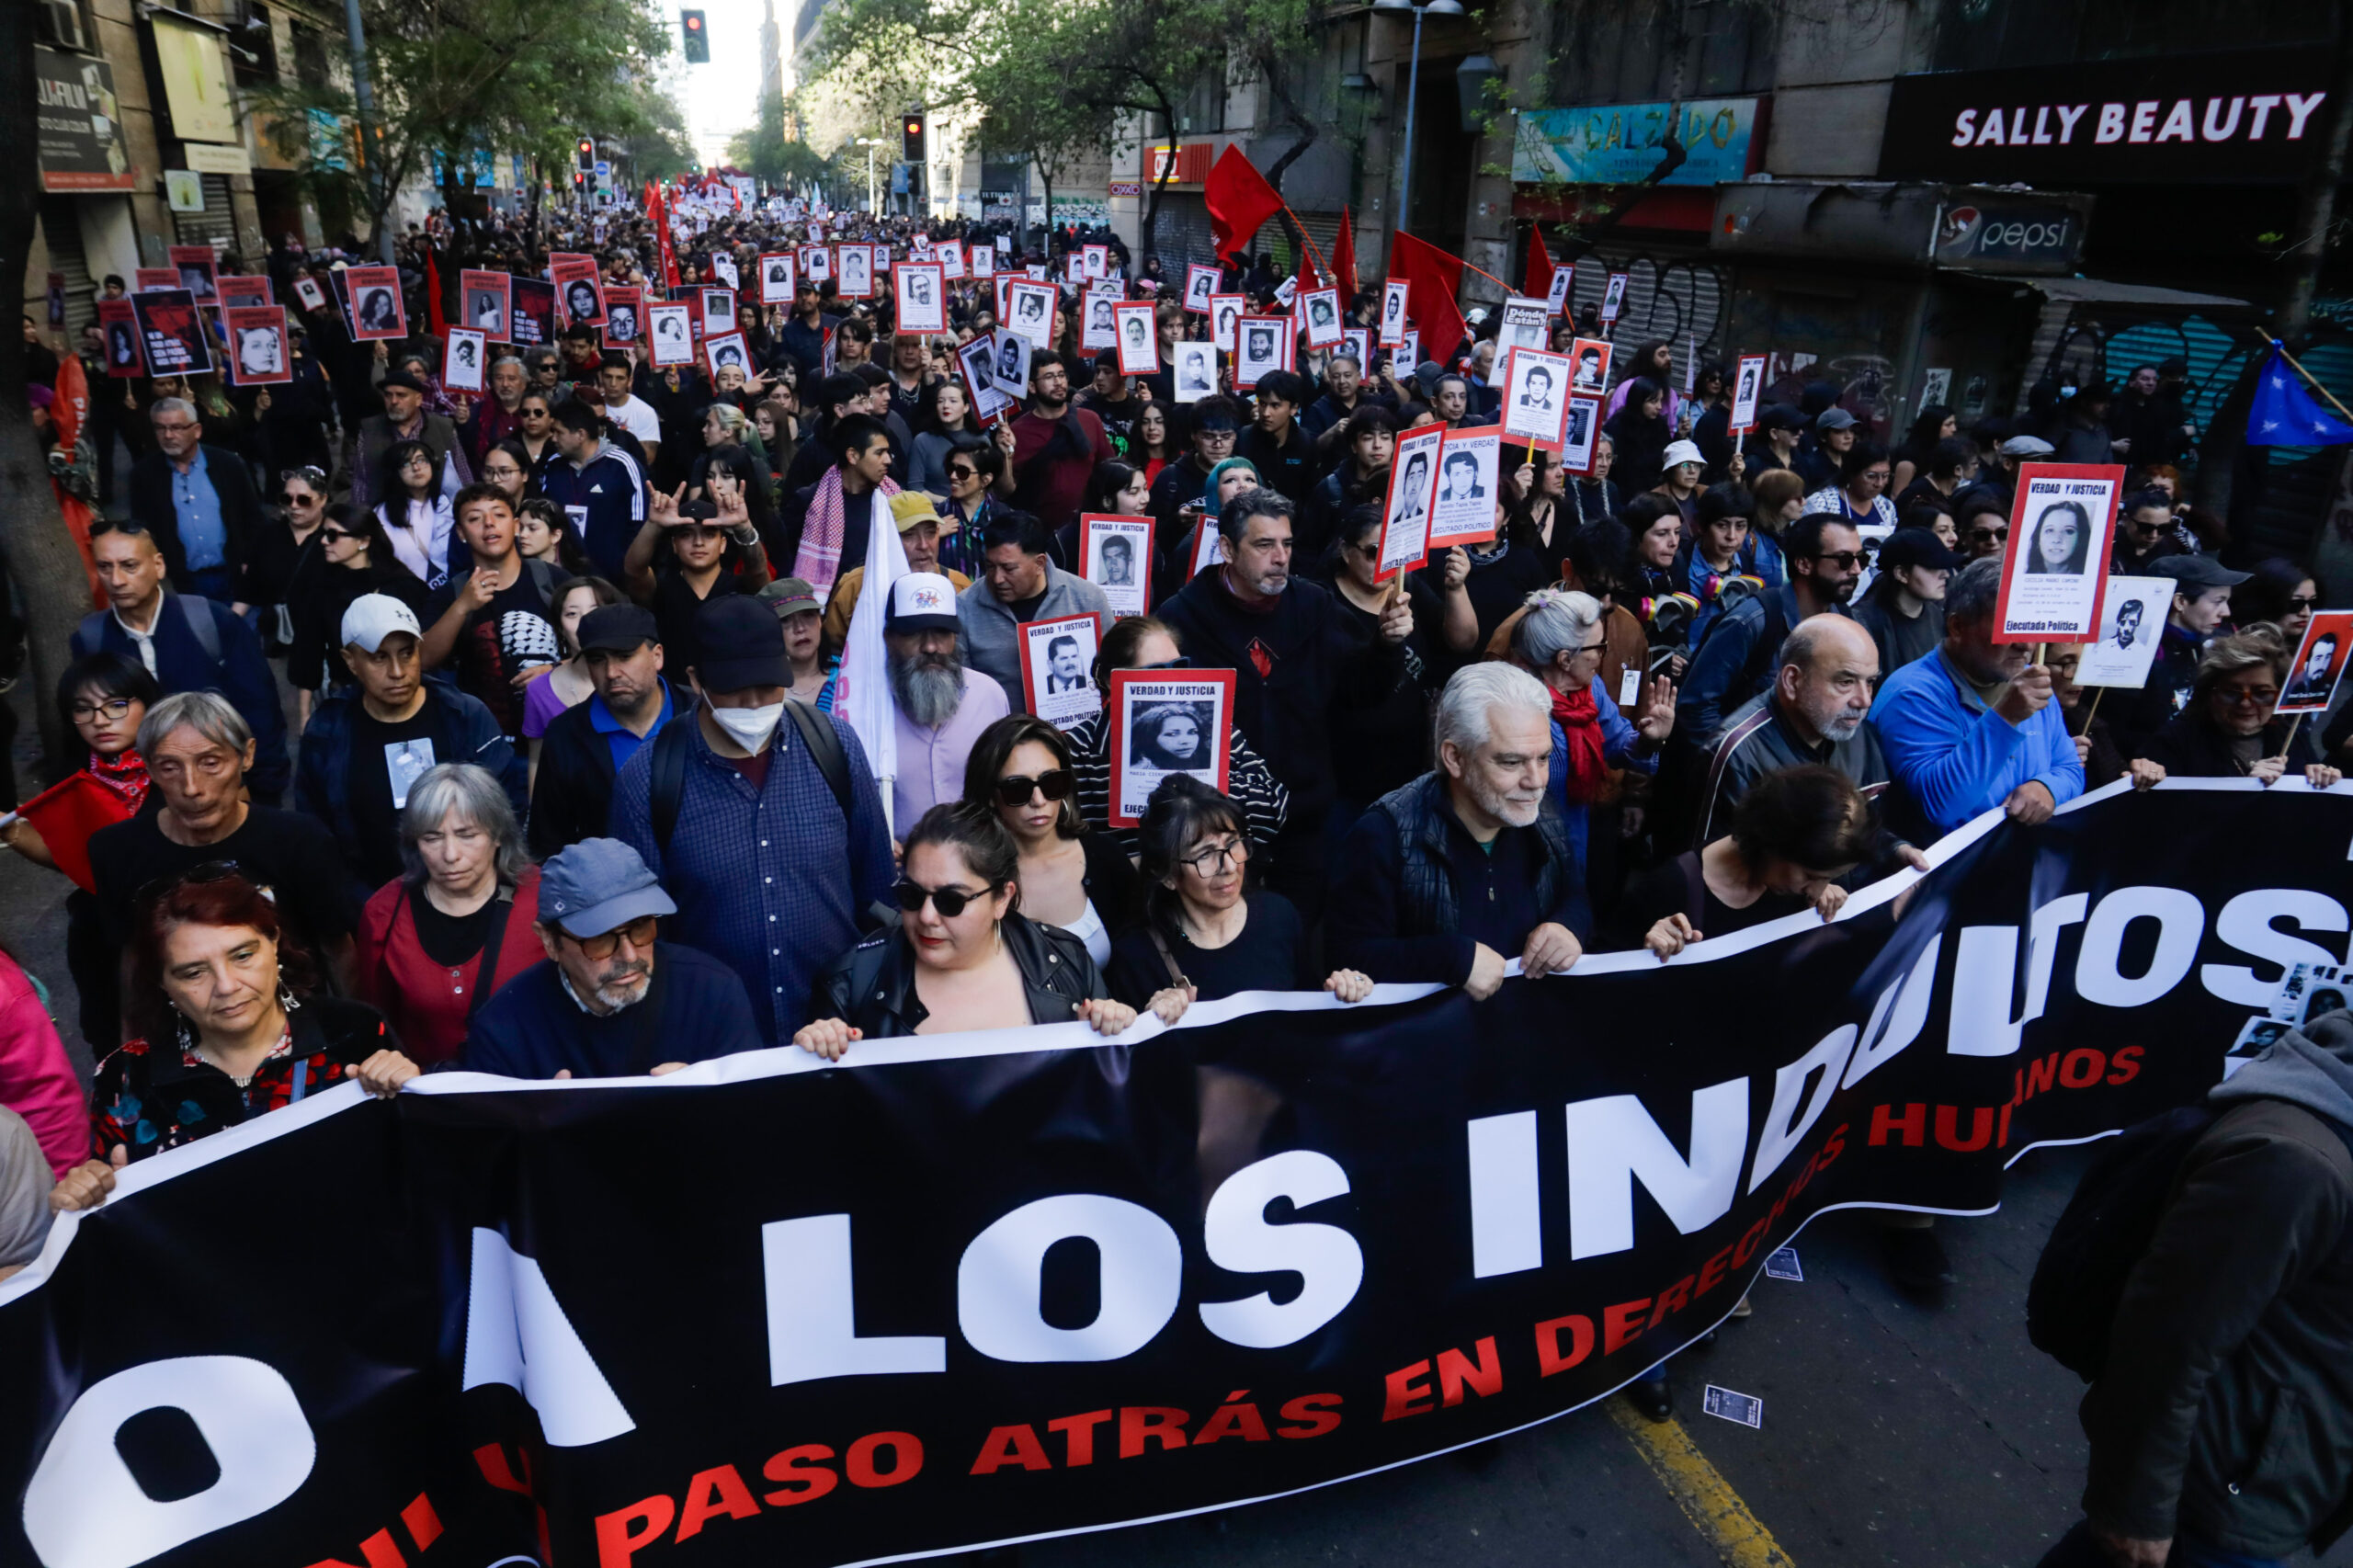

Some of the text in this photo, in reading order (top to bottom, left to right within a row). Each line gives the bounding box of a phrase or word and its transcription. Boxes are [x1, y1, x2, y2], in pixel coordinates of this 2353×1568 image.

[1951, 91, 2326, 147] SALLY BEAUTY
[1584, 107, 1737, 152] CALZDO
[1111, 184, 1141, 195] OXXO
[1981, 217, 2068, 253] pepsi
[1509, 307, 1546, 320] Dónde
[1517, 352, 1538, 361] VERDAD
[1544, 357, 1567, 367] JUSTICIA
[1574, 398, 1594, 407] JUSTICIA
[1401, 440, 1415, 453] VERDAD
[1421, 435, 1438, 448] JUSTICIA
[1443, 441, 1459, 451] TICIA
[1471, 438, 1495, 449] VERDAD
[2030, 483, 2061, 495] VERDAD
[2071, 484, 2106, 495] JUSTICIA
[1091, 523, 1112, 531] VERDAD
[1120, 524, 1145, 532] JUSTICIA
[1432, 524, 1463, 534] JECUTADO
[1029, 627, 1054, 637] VERDAD
[1064, 620, 1091, 631] JUSTICIA
[2006, 620, 2078, 631] Ejecutada Política
[1130, 687, 1166, 696] VERDAD
[1176, 686, 1215, 696] JUSTICIA
[762, 1150, 1364, 1387] LOS
[595, 1431, 924, 1568] PASO
[970, 1390, 1344, 1475] ATRÁS
[1381, 1335, 1503, 1423] EN
[1535, 1123, 1849, 1379] DERECHOS
